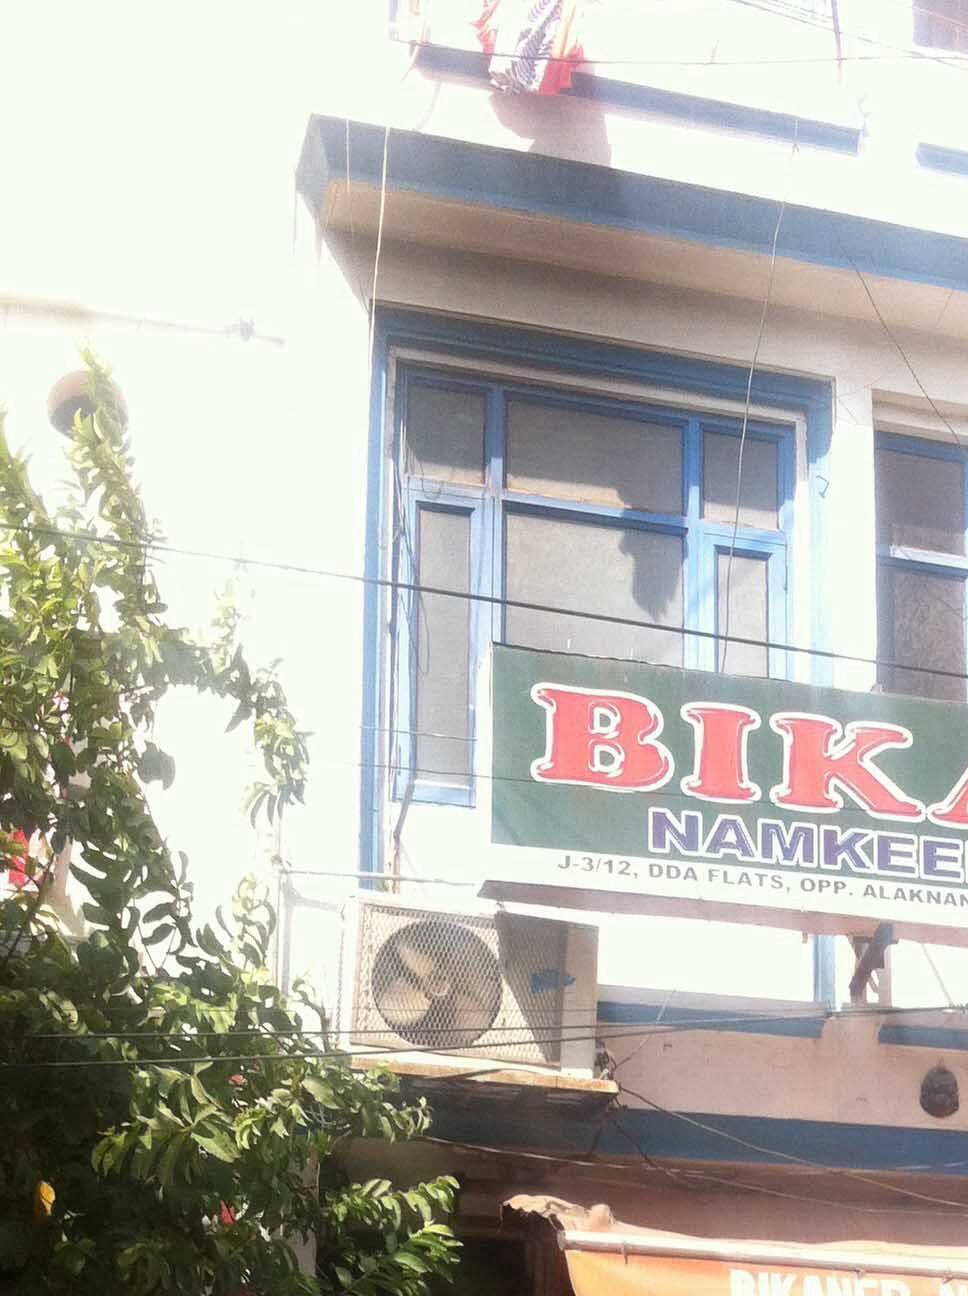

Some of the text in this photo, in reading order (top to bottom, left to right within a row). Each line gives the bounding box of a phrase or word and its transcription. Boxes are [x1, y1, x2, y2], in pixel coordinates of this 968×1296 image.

[558, 855, 638, 880] J-3/12,
[649, 863, 698, 882] DDA
[708, 868, 791, 894] FLATS,
[800, 877, 853, 896] OPP.
